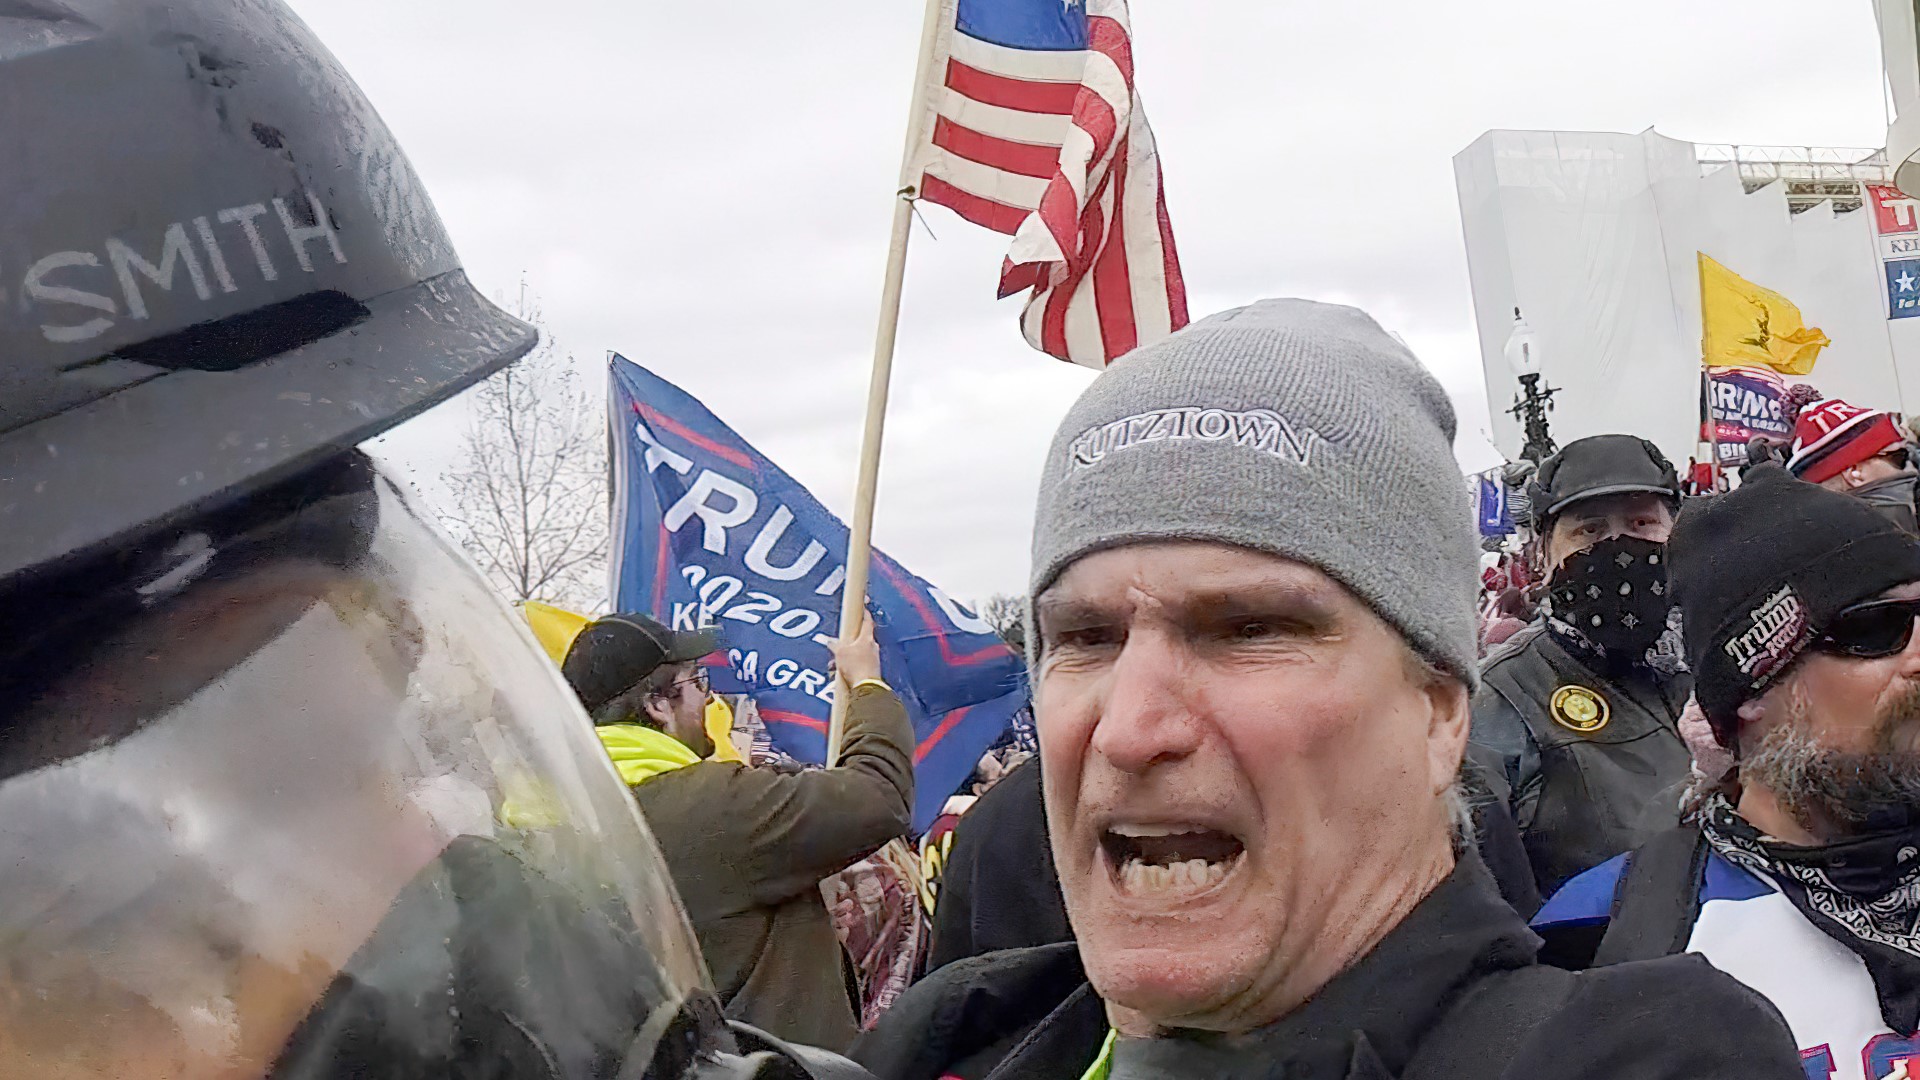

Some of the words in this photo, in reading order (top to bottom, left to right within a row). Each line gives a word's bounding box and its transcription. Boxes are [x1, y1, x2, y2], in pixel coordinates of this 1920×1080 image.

[23, 187, 347, 343] SMITH
[1069, 405, 1318, 470] KUTZTOWN
[1724, 595, 1801, 667] Trump
